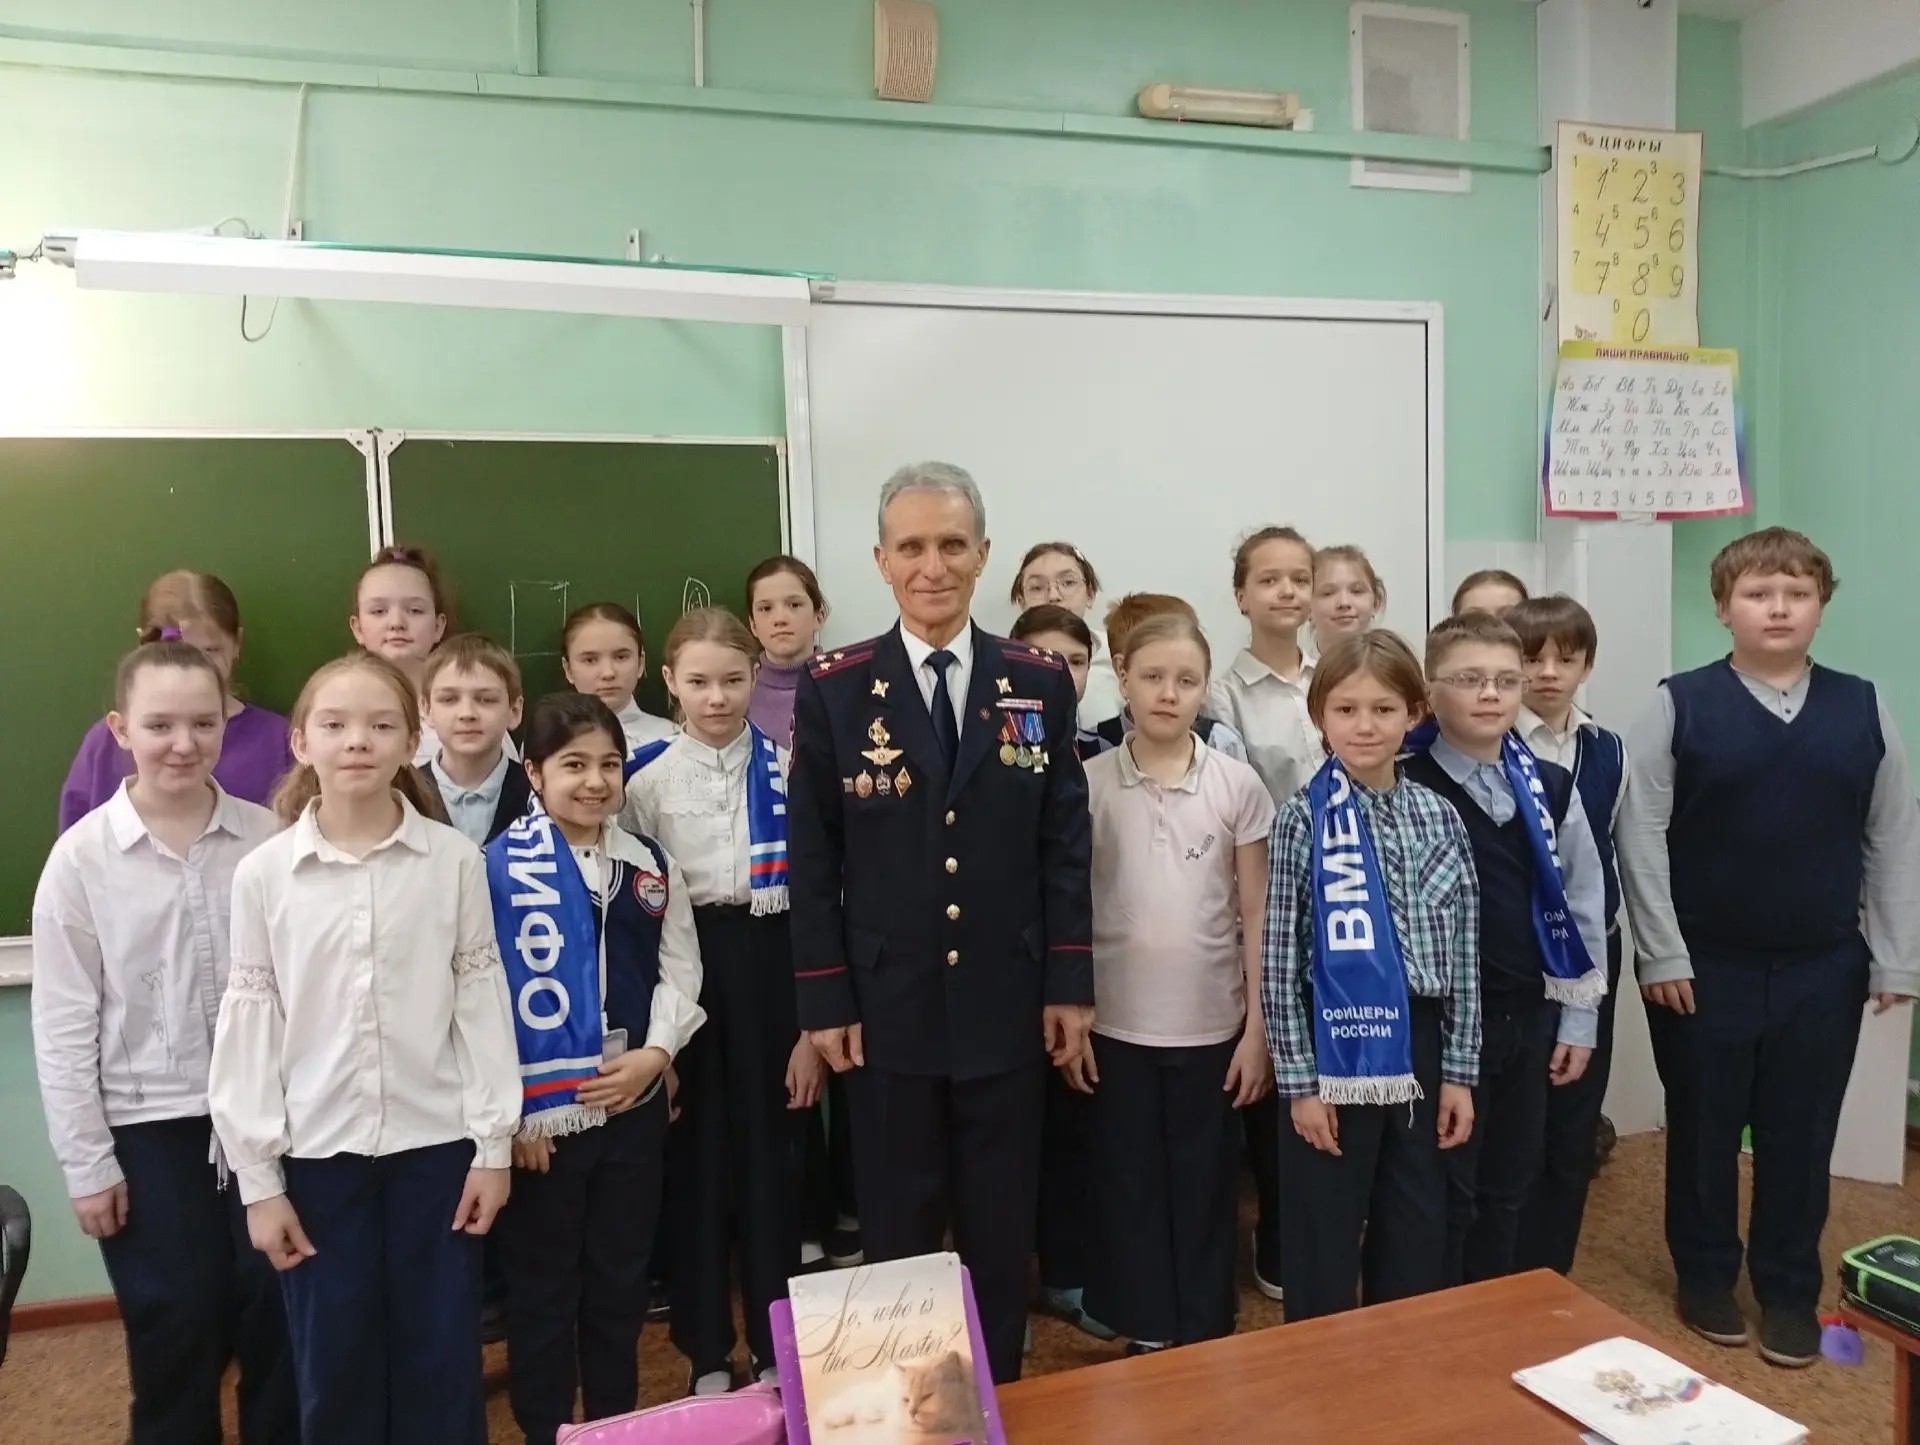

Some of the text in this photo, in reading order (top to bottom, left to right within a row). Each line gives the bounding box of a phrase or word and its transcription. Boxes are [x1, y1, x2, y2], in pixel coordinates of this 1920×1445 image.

[1600, 136, 1662, 152] ЦИФРЫ
[1597, 166, 1609, 200] 1
[1612, 158, 1619, 173] 2
[1633, 169, 1649, 203] 2
[1650, 160, 1657, 175] 3
[1670, 172, 1685, 206] 3
[1596, 213, 1611, 248] 4
[1612, 206, 1619, 220] 5
[1634, 216, 1649, 250] 5
[1669, 218, 1684, 253] 6
[1595, 261, 1611, 295] 7
[1612, 252, 1619, 267] 8
[1632, 263, 1649, 296] 8
[1670, 265, 1684, 298] 9
[1632, 308, 1650, 342] 0
[1595, 348, 1627, 359] ПИШИ
[1629, 350, 1689, 362] ПРАВИЛЬНО
[1558, 490, 1567, 505] 0
[1578, 490, 1583, 504] 1
[1593, 490, 1601, 507] 2
[1611, 490, 1619, 507] 3
[1629, 491, 1636, 505] 4
[1645, 490, 1655, 506] 5
[1665, 491, 1673, 507] 6
[1682, 491, 1692, 505] 7
[1706, 491, 1715, 506] 8
[1322, 1005, 1399, 1022] ОФИЦЕРЫ
[1331, 1023, 1392, 1040] РОССИИ
[872, 1281, 913, 1323] who
[920, 1287, 935, 1315] is
[821, 1321, 963, 1375] the Master?
